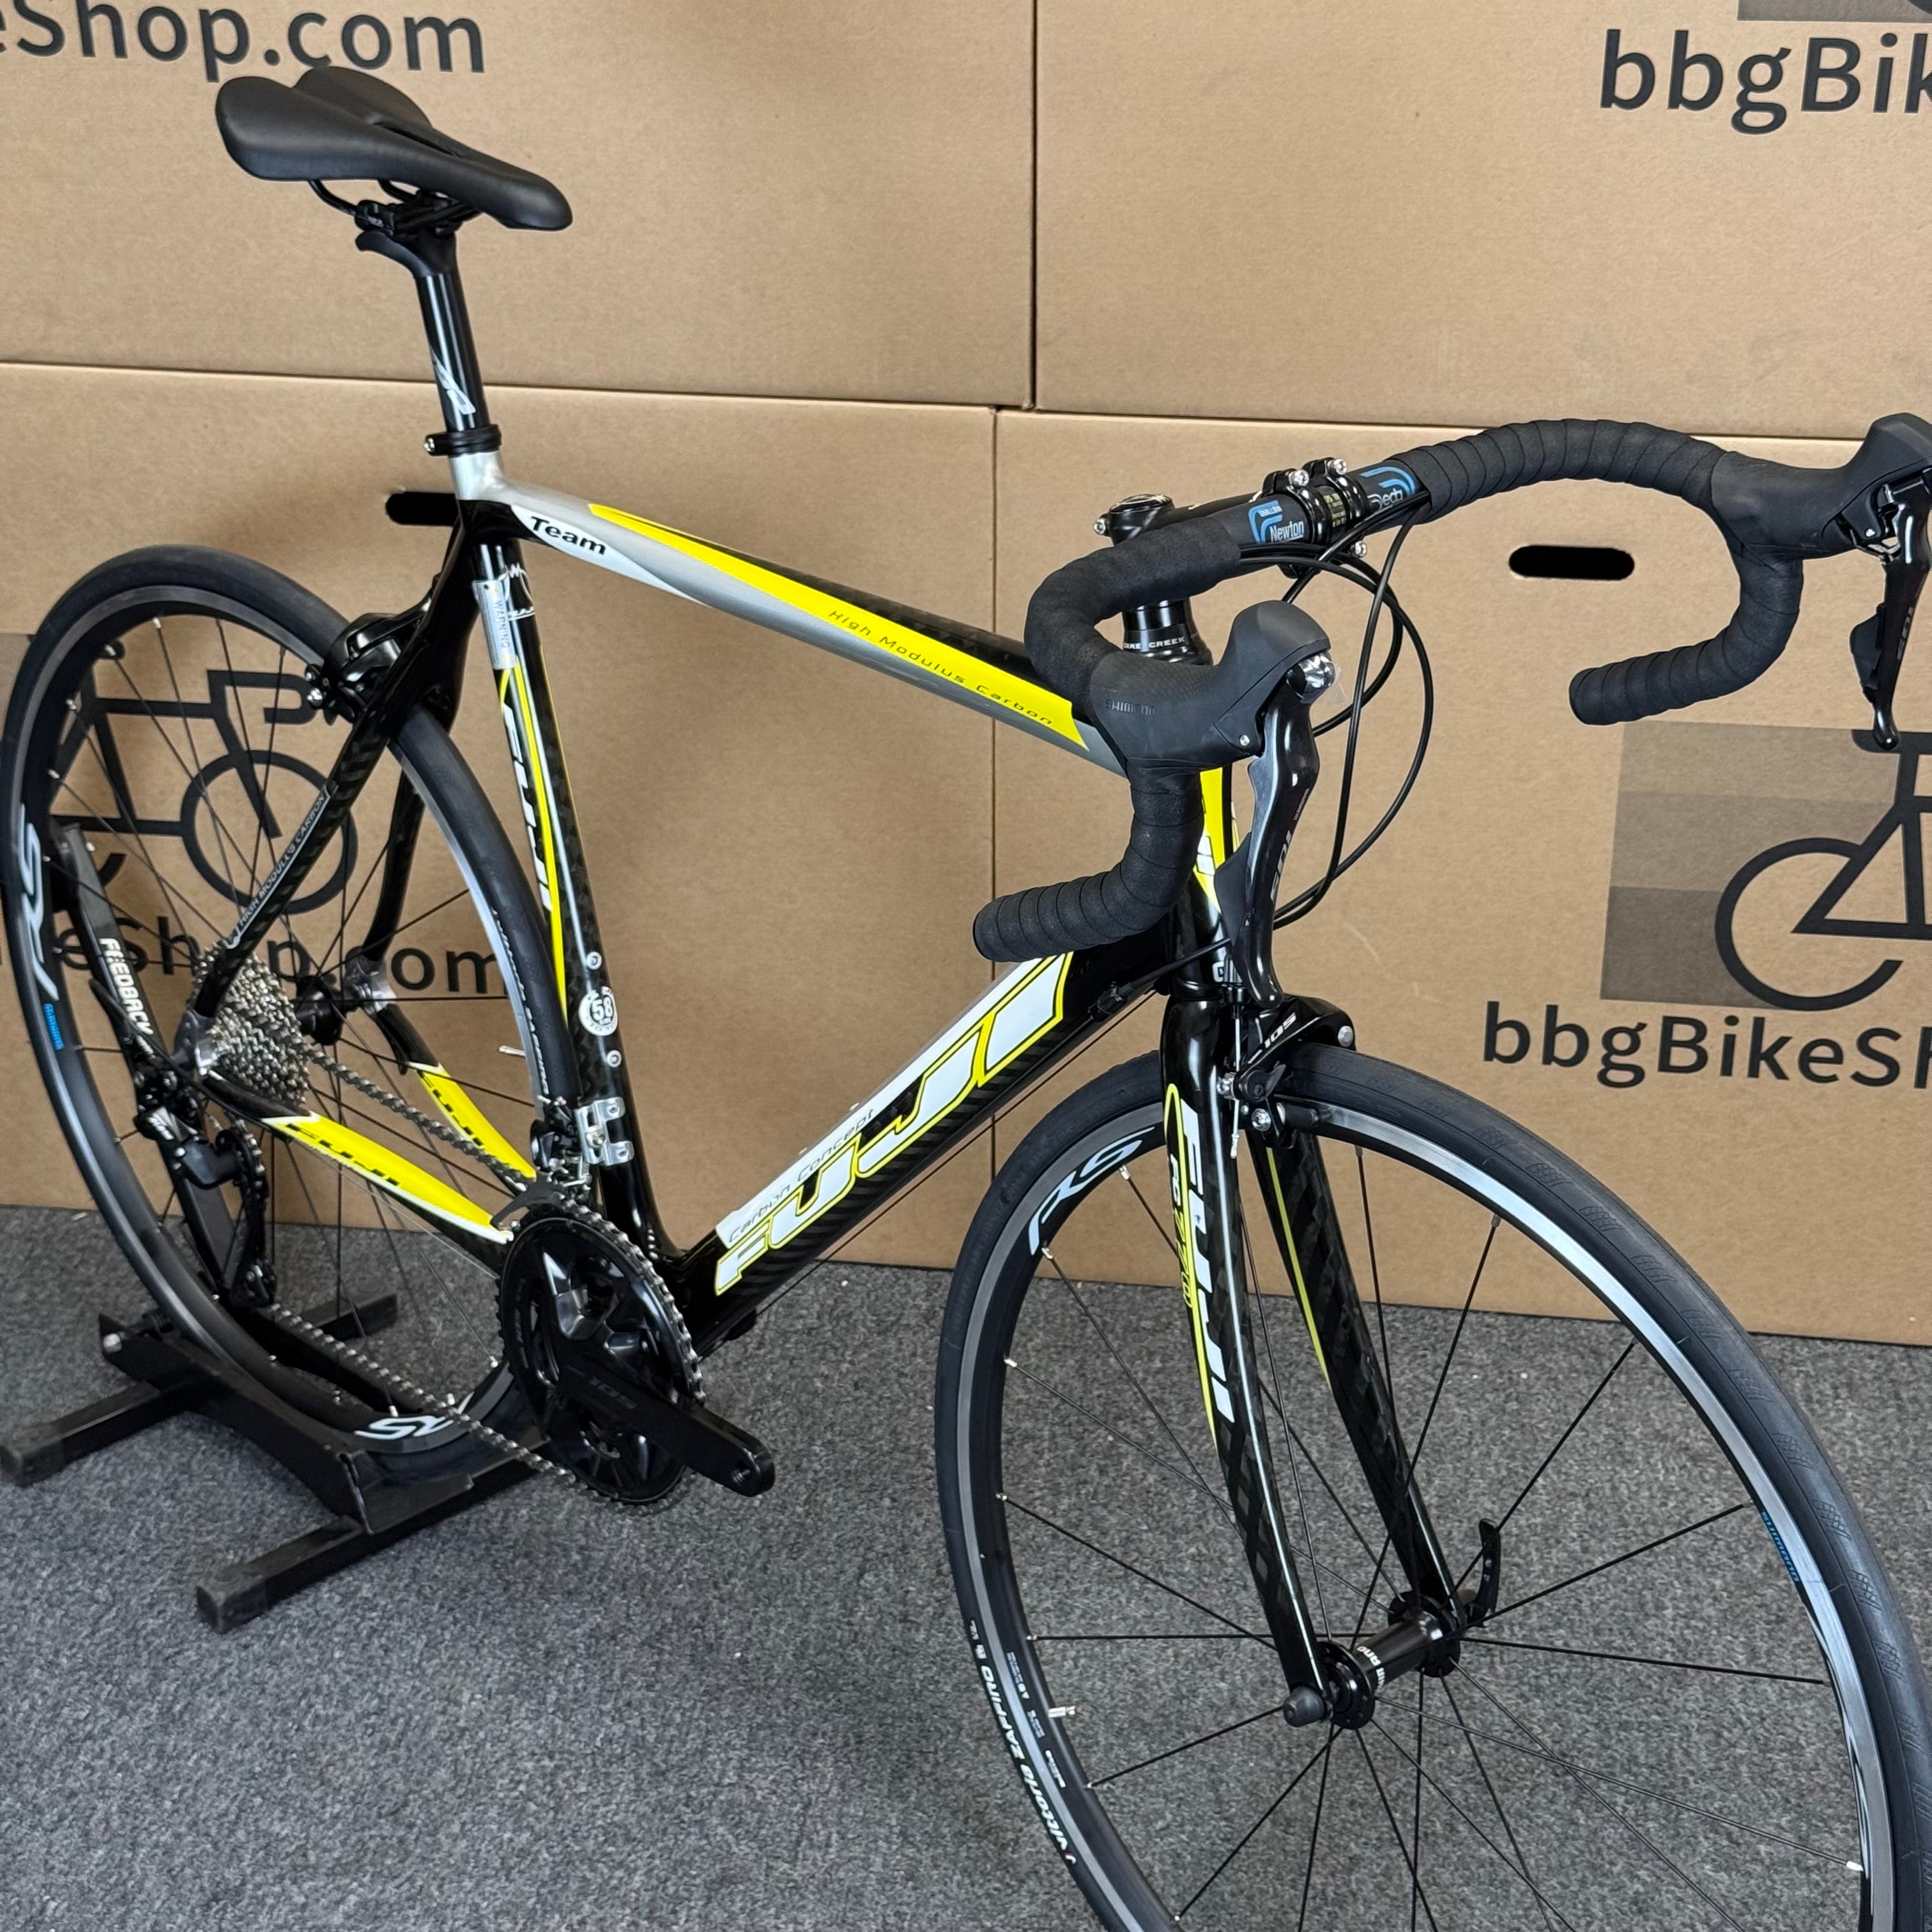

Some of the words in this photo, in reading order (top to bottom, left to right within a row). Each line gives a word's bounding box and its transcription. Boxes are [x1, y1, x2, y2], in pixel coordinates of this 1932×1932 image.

[0, 0, 486, 83] Shop.com
[530, 515, 607, 556] Team
[1269, 521, 1304, 542] Newton
[494, 600, 511, 649] WARNING
[1148, 636, 1186, 648] CREEK
[828, 610, 871, 636] High
[878, 636, 967, 684] Modulus
[976, 684, 1054, 725] Carbon
[1264, 1012, 1297, 1049] 105
[714, 951, 1075, 1297] FUJI
[797, 1108, 875, 1182] Concept
[1028, 1126, 1156, 1256] RS
[980, 1664, 1025, 1760] ZAFFIRO
[1020, 1763, 1068, 1851] vittoria
